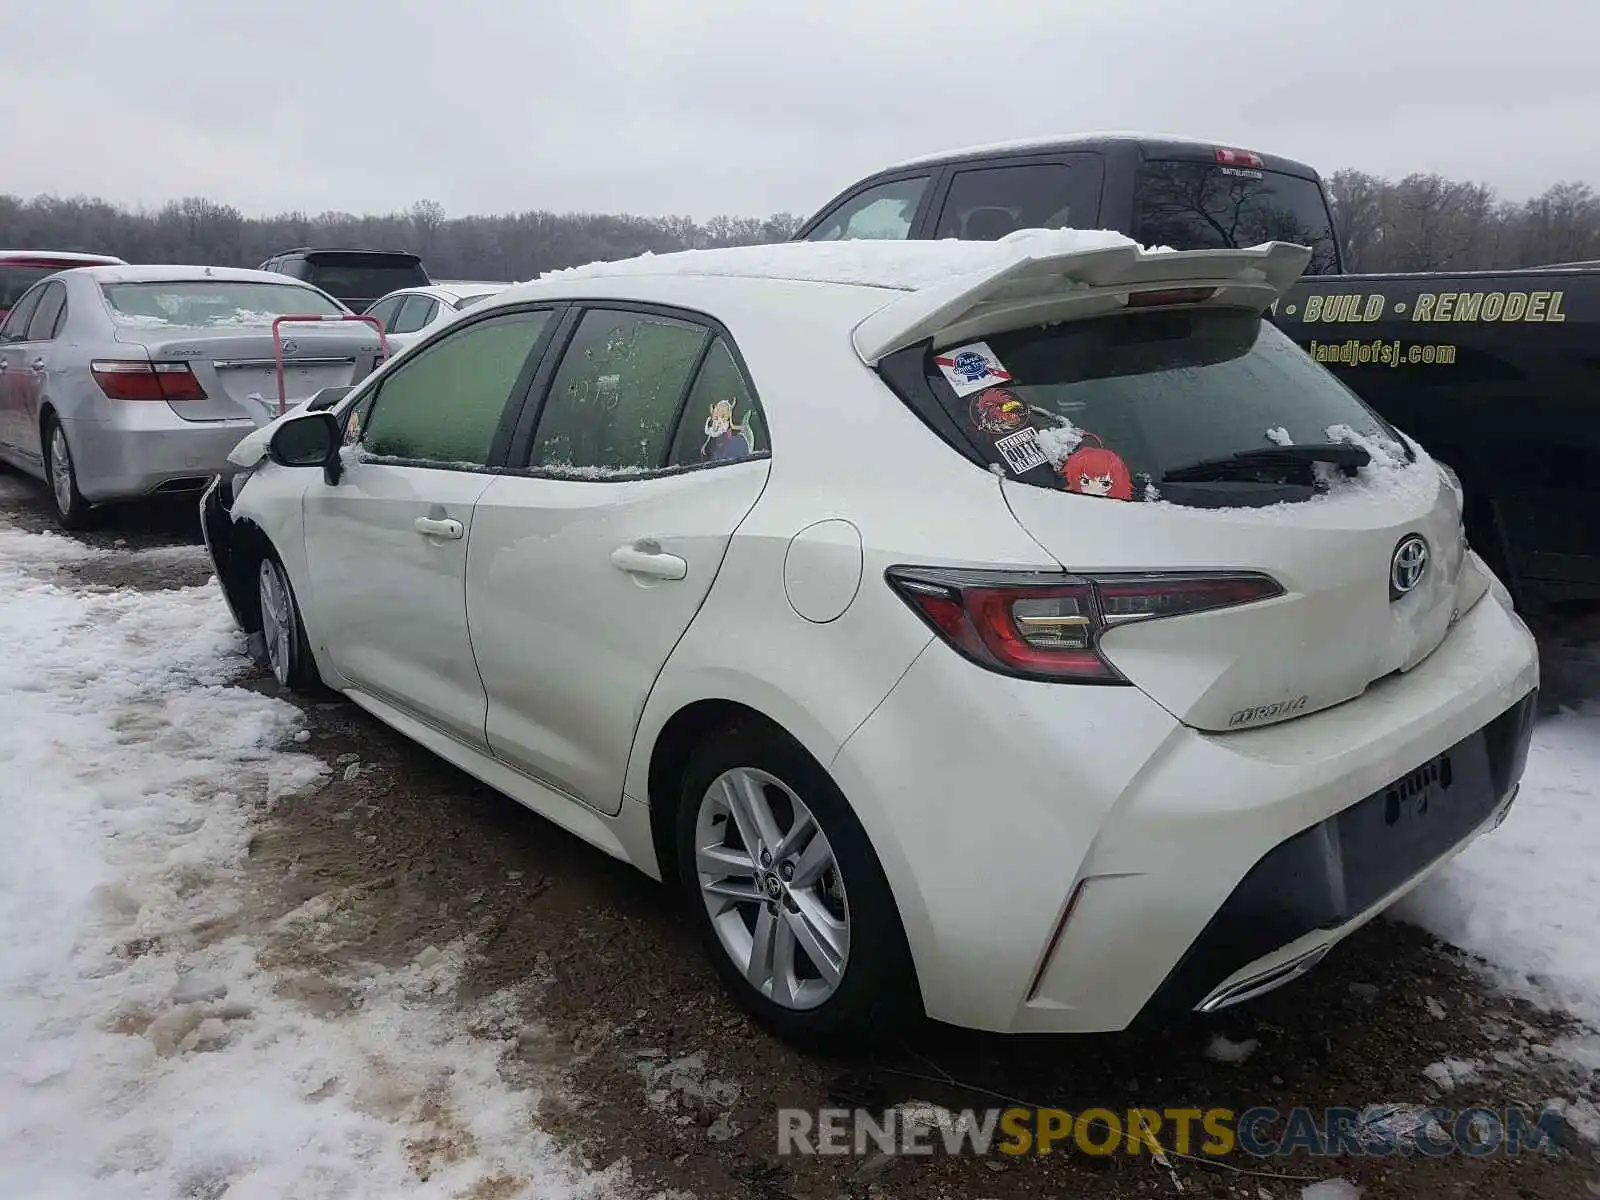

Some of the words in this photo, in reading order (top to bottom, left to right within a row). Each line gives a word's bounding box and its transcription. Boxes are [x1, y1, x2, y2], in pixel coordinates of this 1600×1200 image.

[1303, 295, 1385, 323] BUILD
[1411, 291, 1566, 322] REMODEL
[1000, 429, 1035, 451] STRAIGHT
[1013, 451, 1048, 472] DELAWAR
